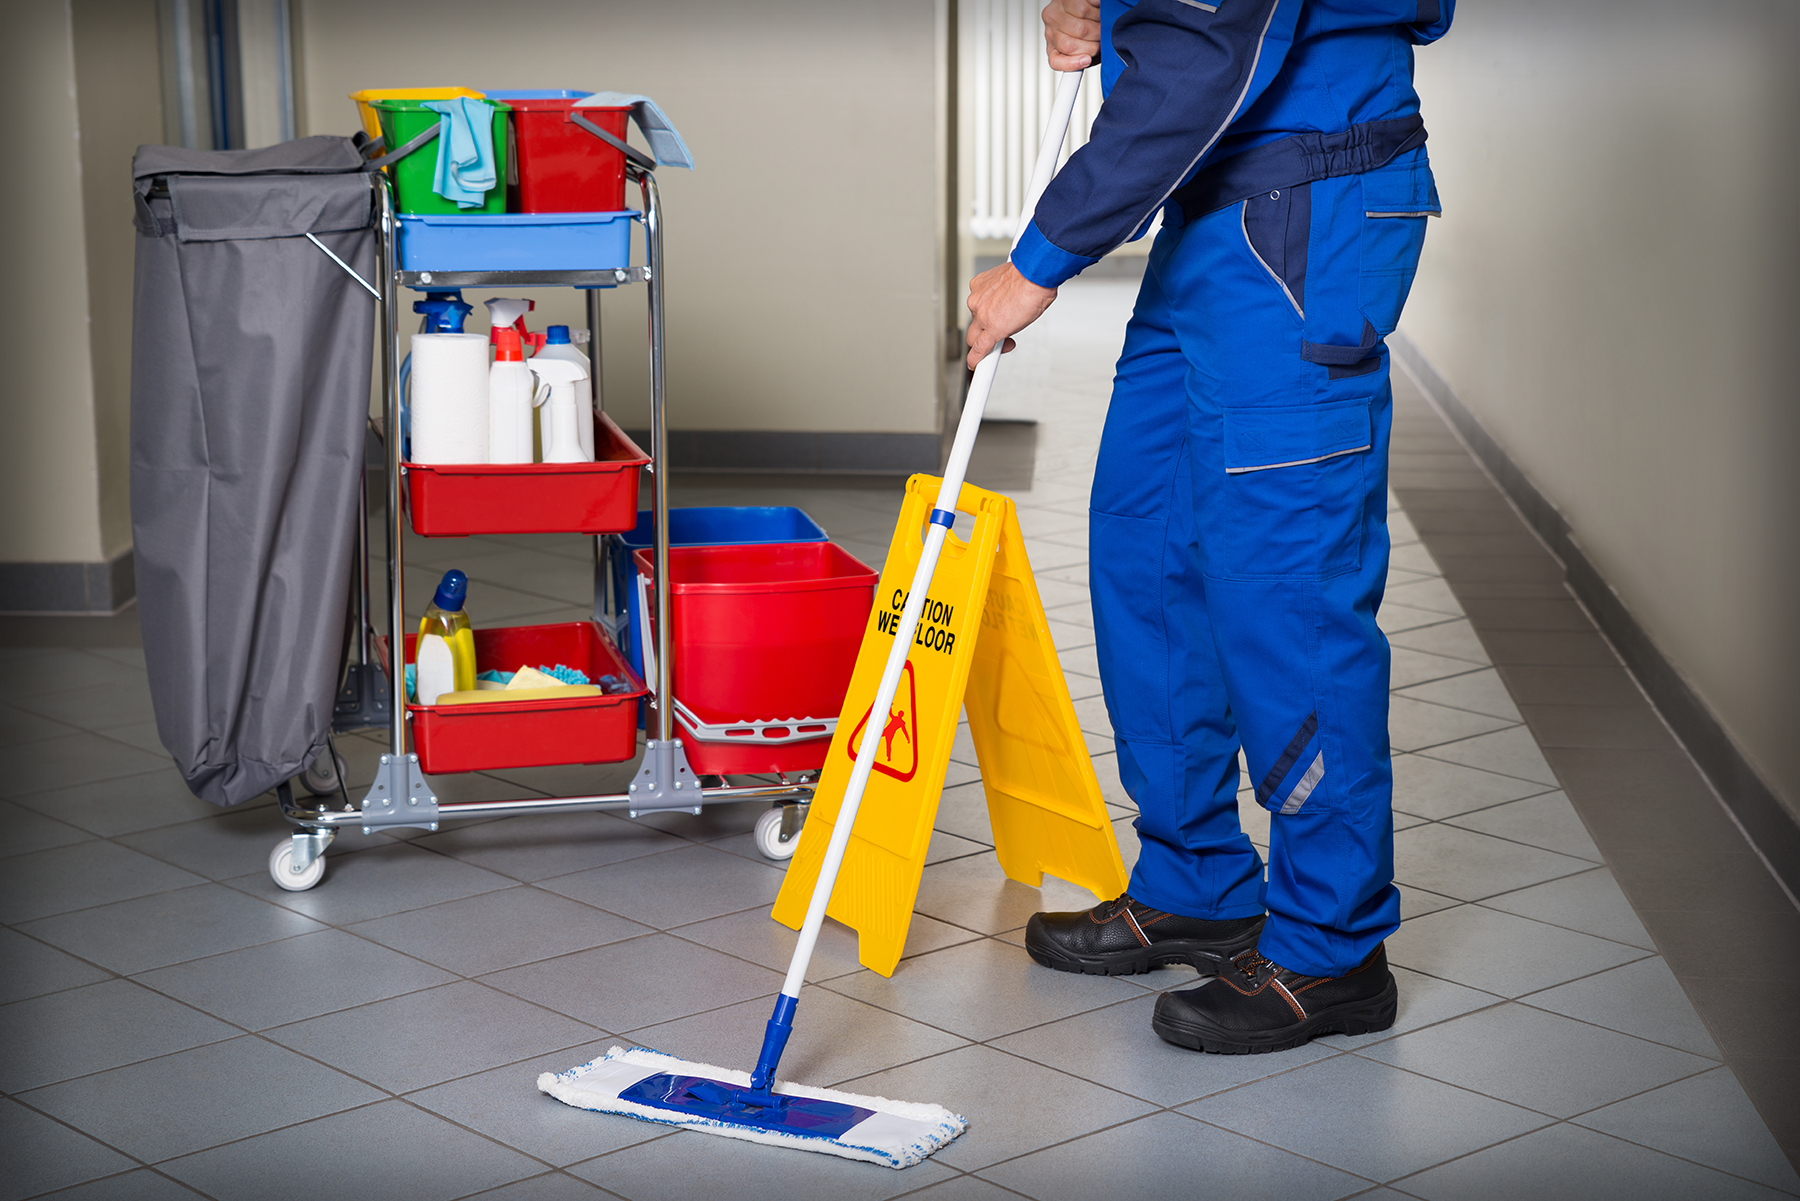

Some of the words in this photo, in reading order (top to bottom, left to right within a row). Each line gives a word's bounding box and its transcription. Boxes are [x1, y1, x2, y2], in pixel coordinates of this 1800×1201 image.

[892, 588, 954, 627] CATION
[877, 610, 901, 636] WE
[914, 622, 955, 655] LOOR
